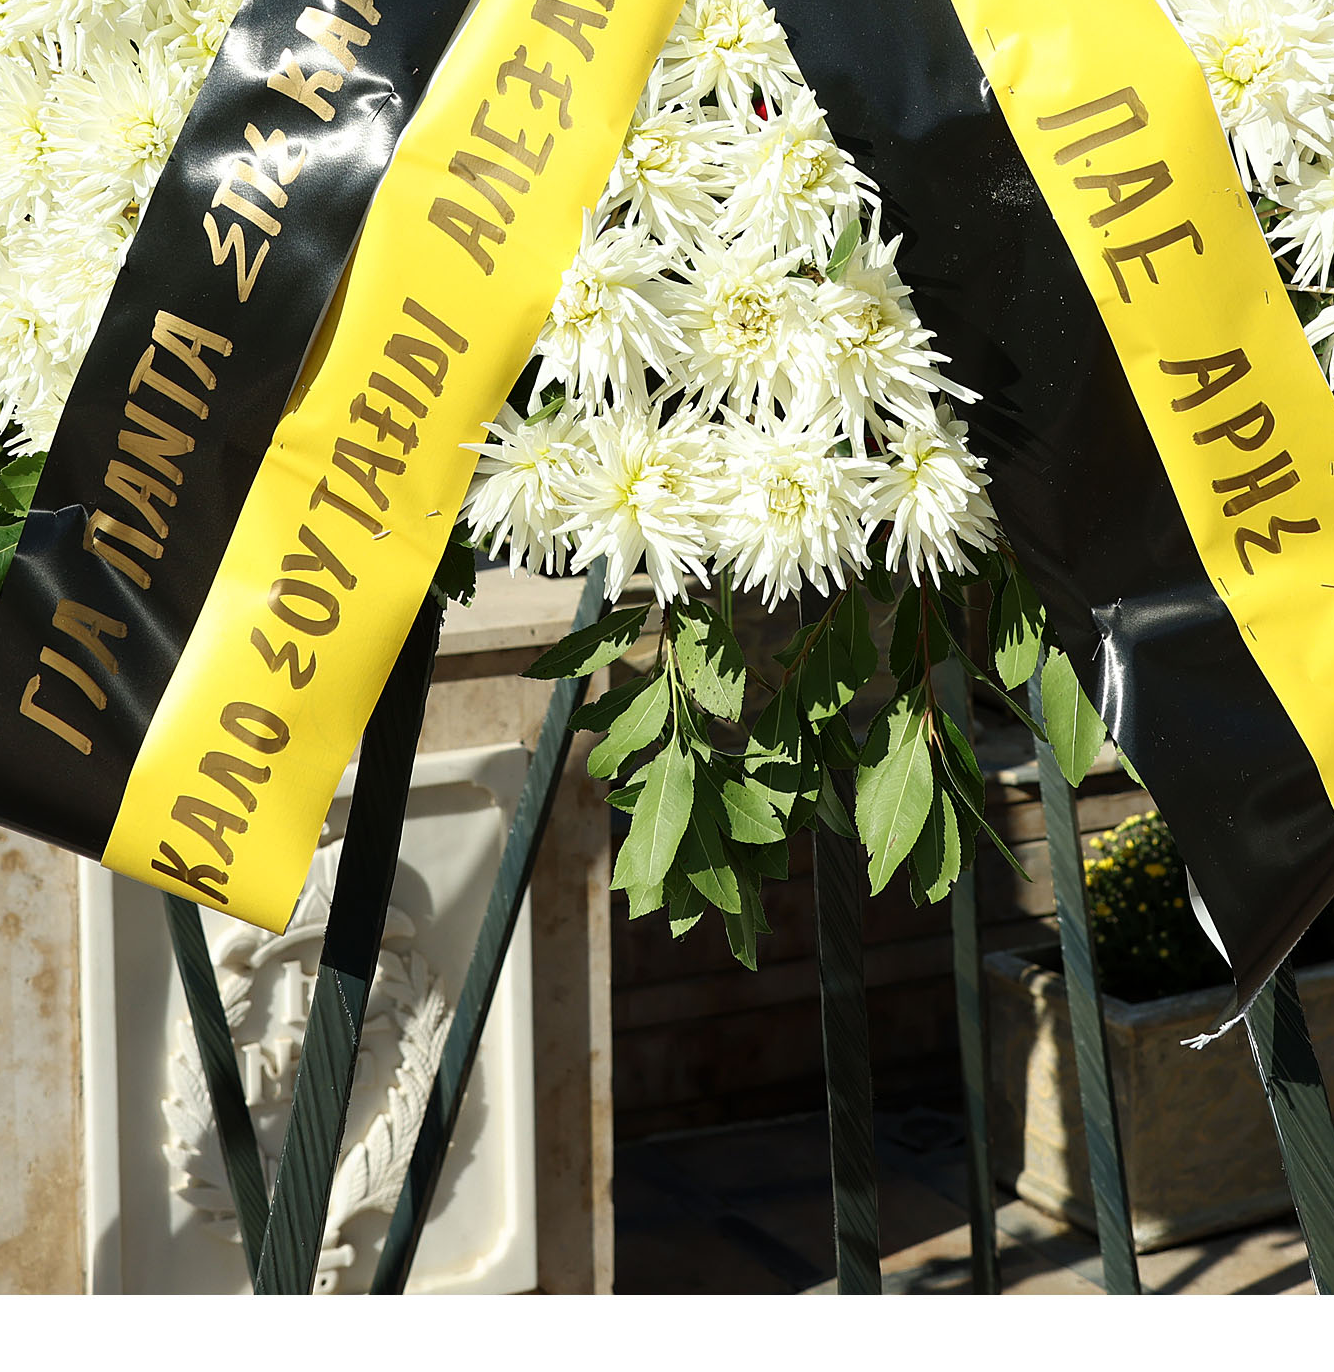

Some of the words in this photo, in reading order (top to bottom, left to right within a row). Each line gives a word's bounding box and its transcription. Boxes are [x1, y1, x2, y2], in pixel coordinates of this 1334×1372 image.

[19, 597, 129, 756] ΓΙΑ
[82, 310, 234, 592] ΠΑΝΤΑ
[150, 699, 291, 906] ΚΑΛΟ
[249, 524, 358, 692] ΣΟΥ
[308, 296, 470, 536] ΤΑΞΙΔΙ
[1158, 347, 1322, 576] ΑΡΗΣ
